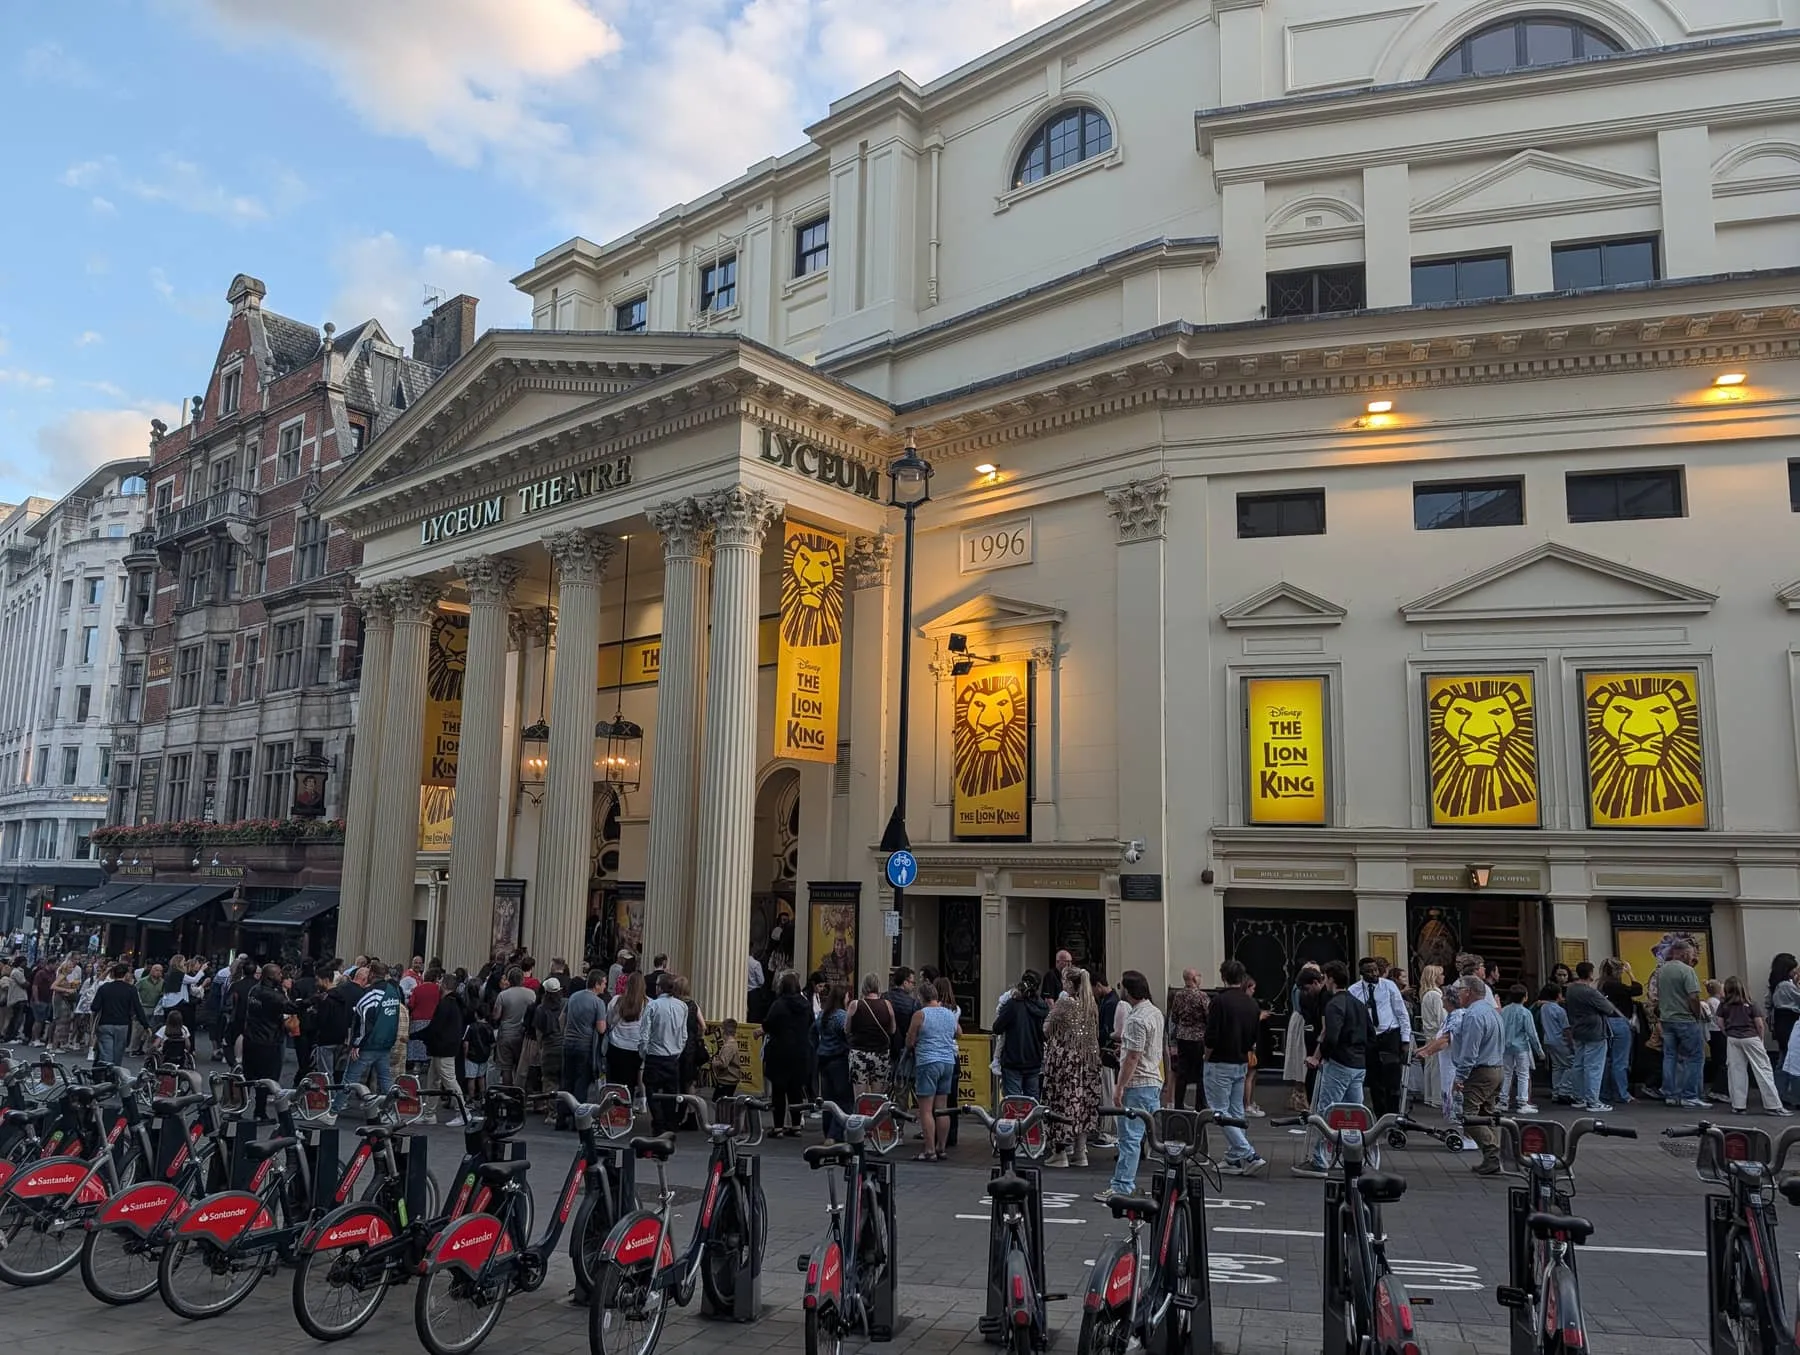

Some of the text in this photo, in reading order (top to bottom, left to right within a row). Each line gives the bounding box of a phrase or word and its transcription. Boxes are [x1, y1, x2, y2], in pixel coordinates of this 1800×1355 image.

[760, 427, 880, 499] LYCEUM
[421, 455, 632, 545] LYCEUM THEATRE
[969, 527, 1025, 563] 1996
[641, 648, 660, 667] TH
[796, 657, 821, 673] Disney
[797, 673, 820, 690] THE
[791, 692, 822, 719] LION
[1266, 705, 1302, 720] Disney
[786, 719, 825, 750] KING
[1269, 721, 1302, 736] THE
[1263, 742, 1308, 768] LION
[432, 757, 457, 779] KIN
[1260, 770, 1315, 799] KING
[960, 809, 1020, 824] THE LION KING
[1617, 913, 1704, 924] LYCEUM THEATRE
[739, 1056, 751, 1064] ON
[959, 1055, 969, 1064] HE
[741, 1072, 752, 1080] NG
[958, 1071, 971, 1080] ON
[958, 1088, 976, 1098] NG
[37, 1175, 76, 1185] Santander
[129, 1197, 168, 1211] Santander
[209, 1208, 247, 1221] Santander
[337, 1226, 368, 1239] Santander
[460, 1232, 493, 1248] Santander
[631, 1233, 656, 1249] Santander
